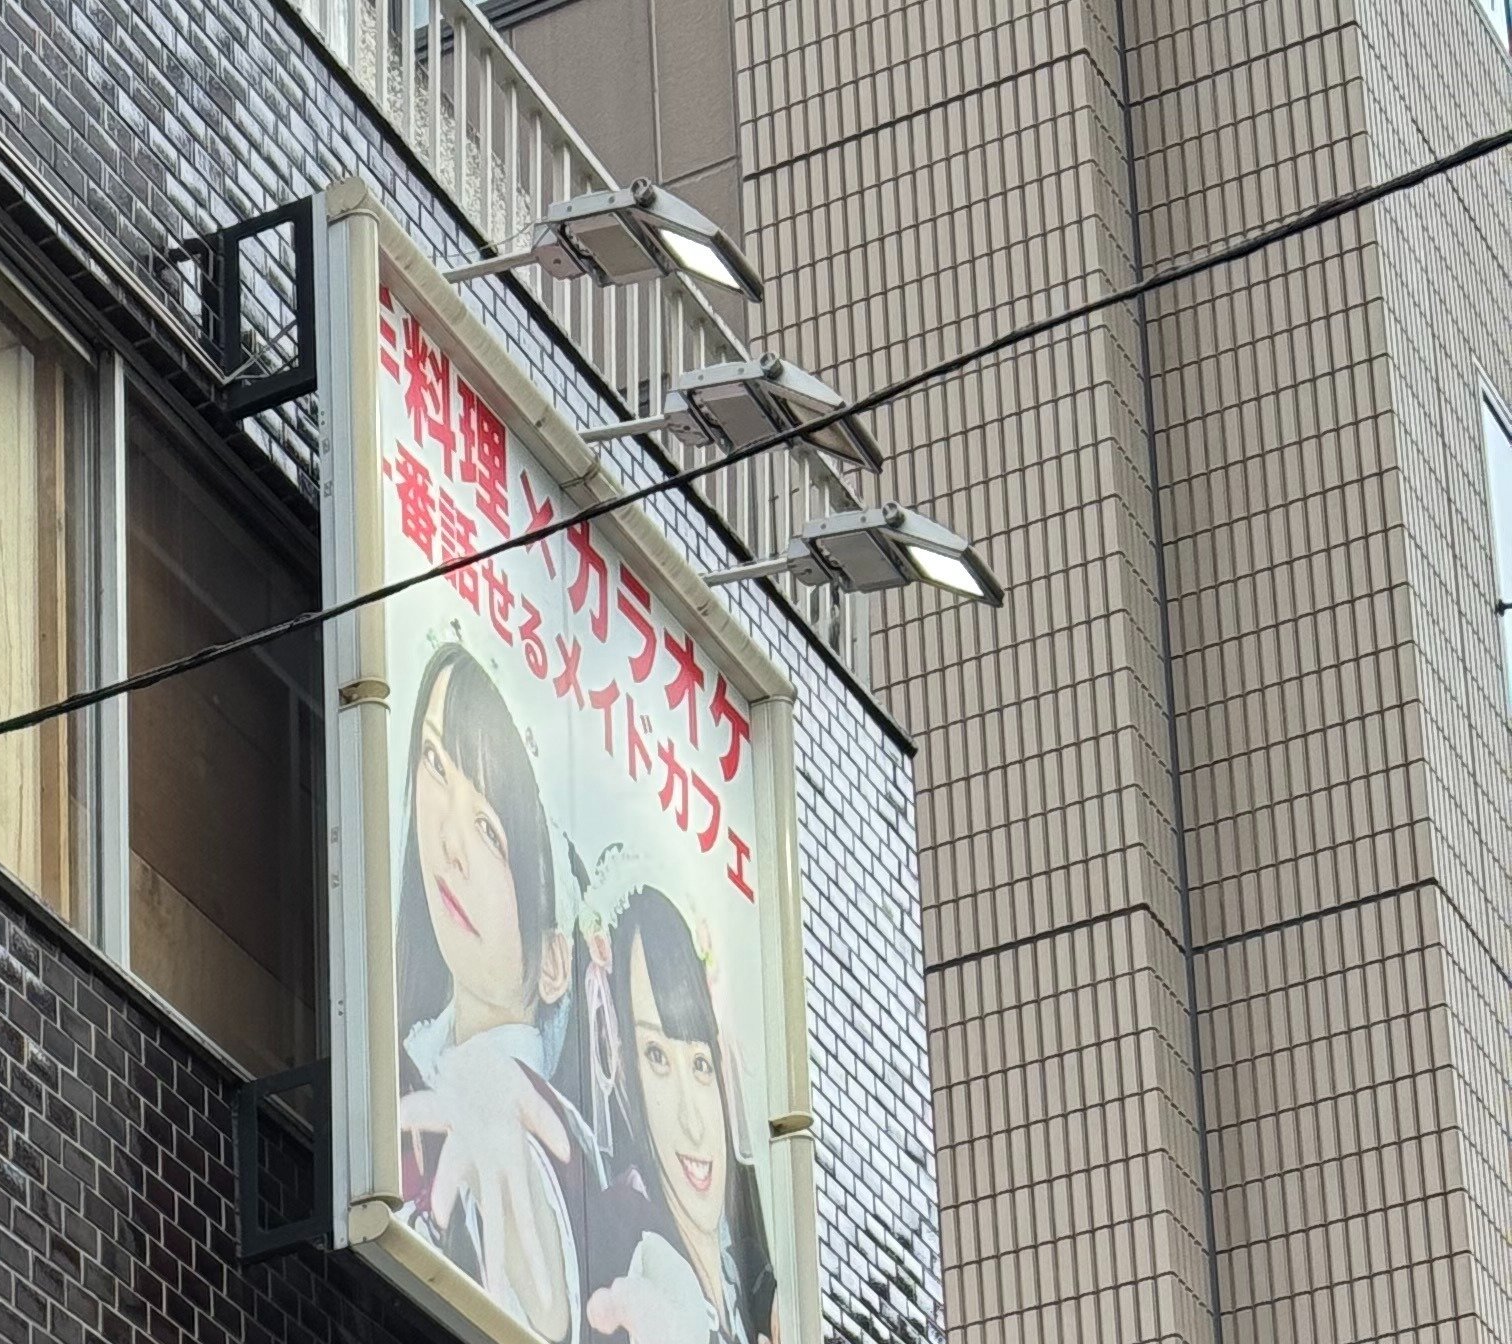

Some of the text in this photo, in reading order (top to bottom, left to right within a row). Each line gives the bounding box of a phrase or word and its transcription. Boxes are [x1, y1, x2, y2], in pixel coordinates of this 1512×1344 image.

[383, 438, 752, 904] 番話せるメイドカフェ
